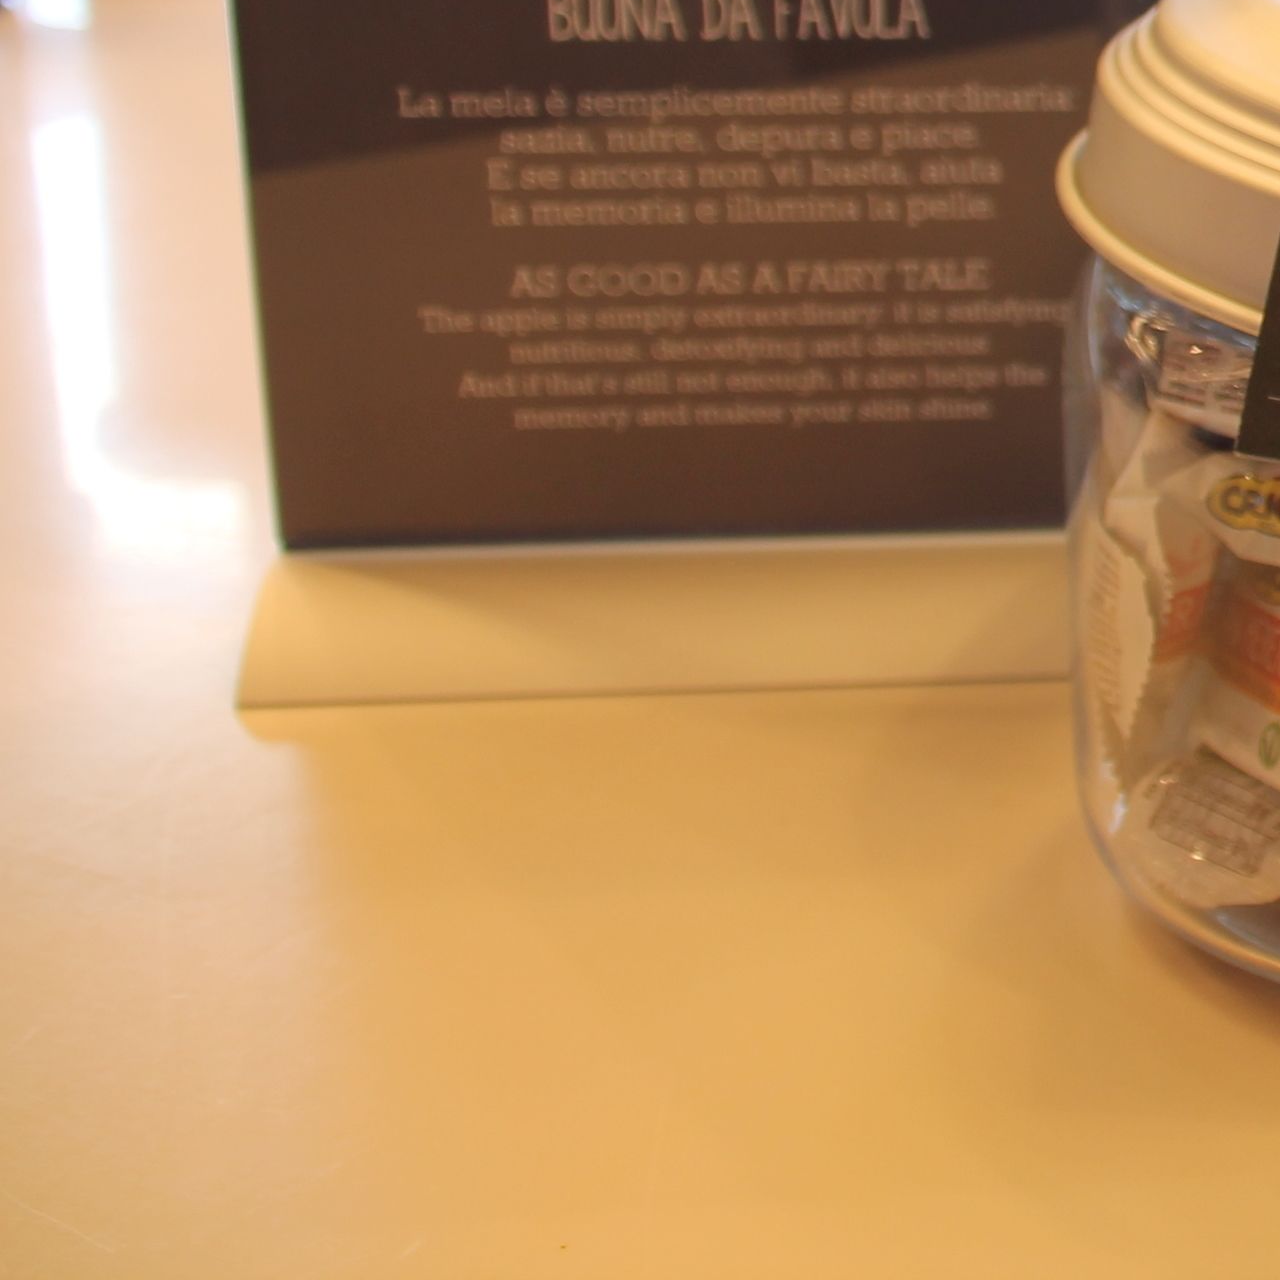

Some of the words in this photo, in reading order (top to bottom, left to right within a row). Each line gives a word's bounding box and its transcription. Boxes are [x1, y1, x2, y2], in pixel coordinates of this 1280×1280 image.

[396, 85, 441, 118] La
[449, 88, 538, 117] mela
[576, 84, 844, 123] semplicemente
[716, 123, 844, 158] depura
[851, 125, 872, 151] e
[486, 158, 513, 190] E
[520, 164, 560, 190] se
[570, 162, 690, 190] ancora
[698, 161, 764, 188] non
[770, 158, 803, 187] vi
[919, 156, 1003, 185] aiuta
[491, 192, 521, 225] la
[531, 194, 690, 224] memoria
[695, 199, 718, 222] e
[725, 190, 861, 222] illumina
[867, 191, 899, 220] la
[510, 264, 560, 298] AS
[567, 263, 692, 296] GOOD
[697, 263, 746, 295] AS
[752, 261, 781, 294] A
[787, 259, 891, 293] FAIRY
[894, 257, 992, 291] TALE
[416, 304, 474, 333] The
[479, 305, 561, 337] apple
[458, 369, 519, 398] And
